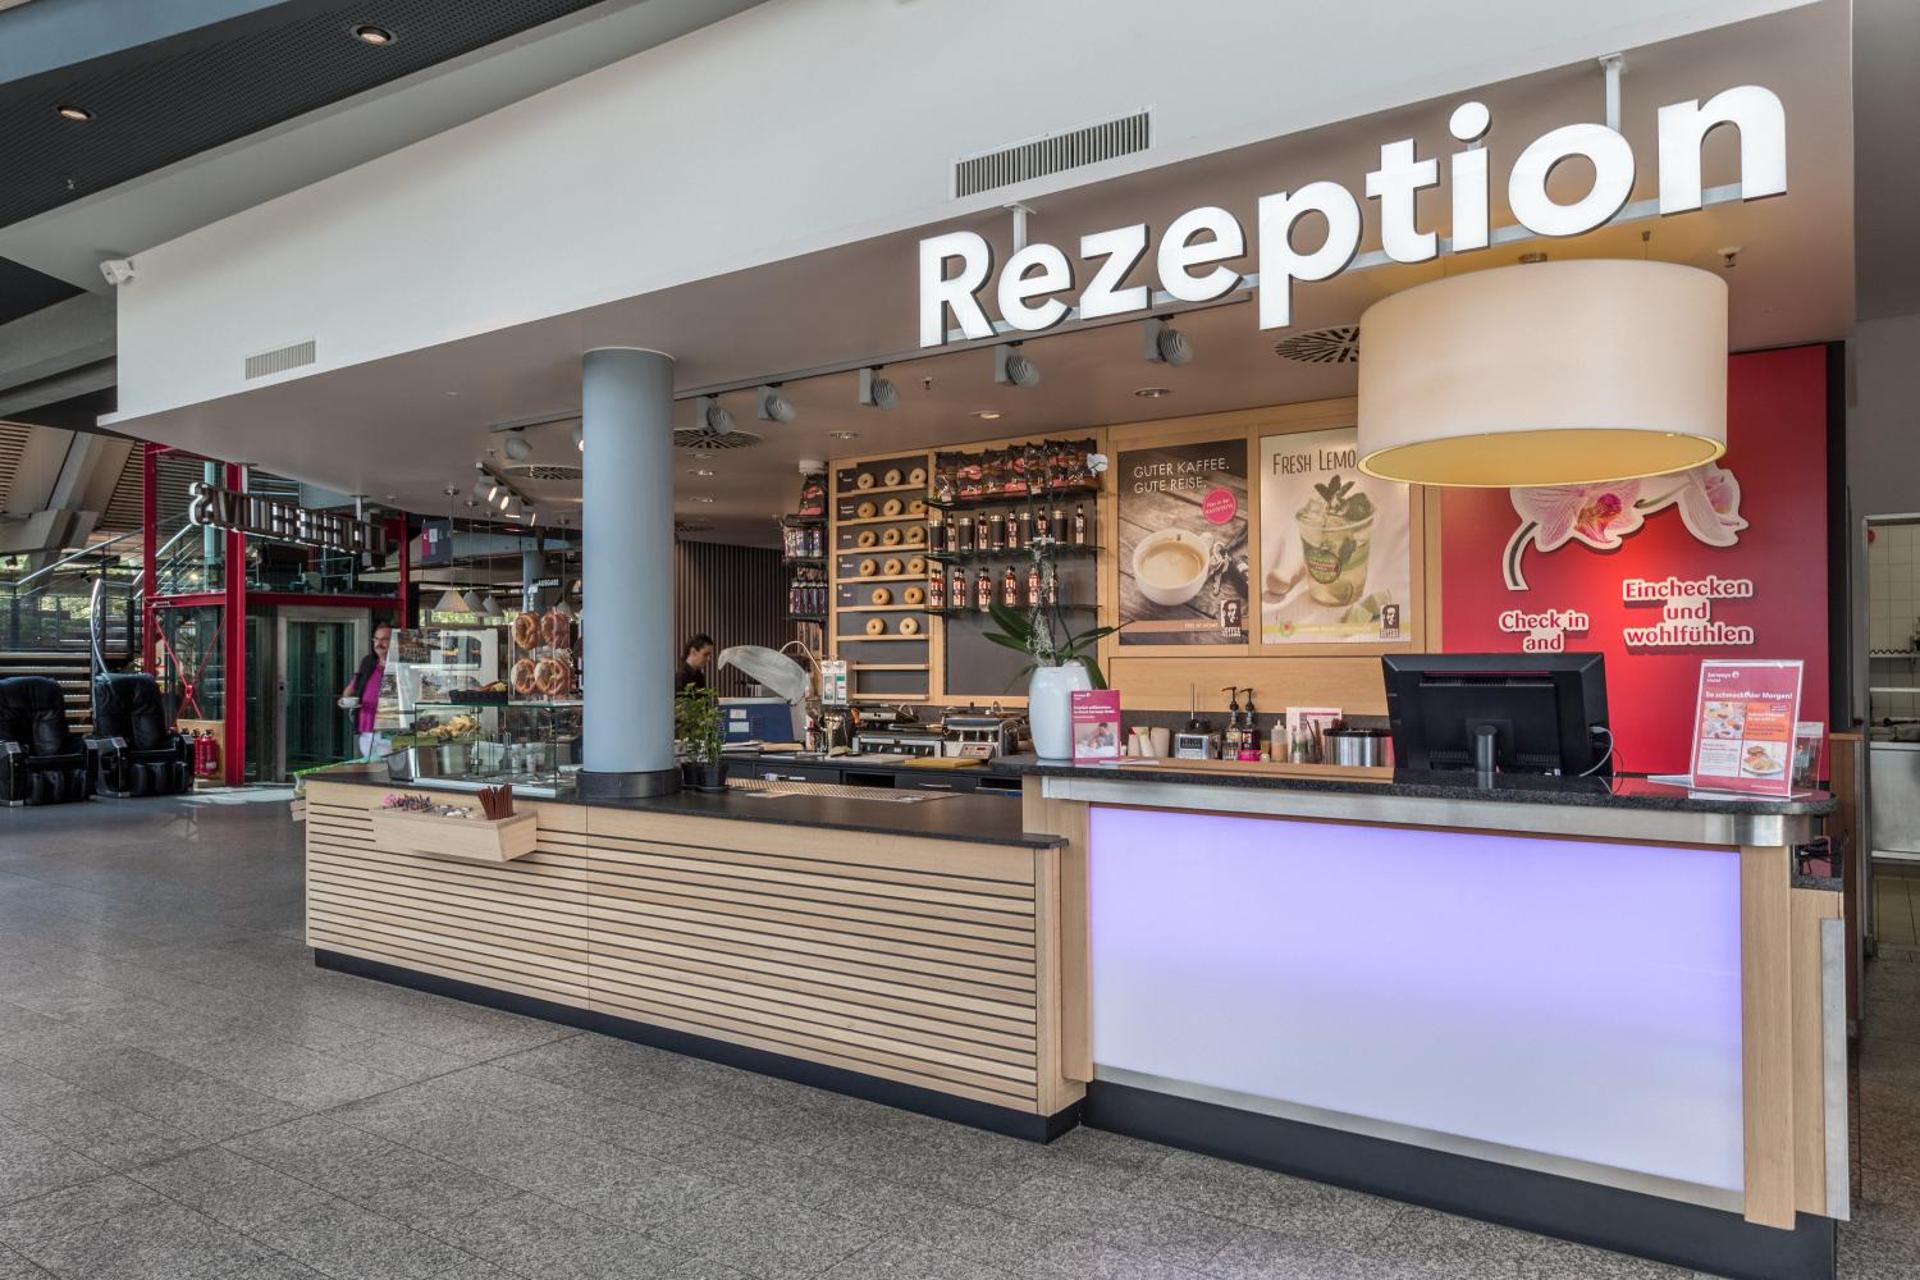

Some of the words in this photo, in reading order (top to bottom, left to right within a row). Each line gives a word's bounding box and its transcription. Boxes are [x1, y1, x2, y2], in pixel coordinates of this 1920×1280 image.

[917, 83, 1788, 348] Rezeption
[1133, 463, 1173, 478] GUTER
[1177, 457, 1230, 473] KAFFEE.
[1273, 453, 1312, 475] FRESH
[1133, 479, 1166, 494] GUTE
[1170, 477, 1207, 491] REISE.
[1624, 578, 1751, 599] Einchecken
[1666, 600, 1709, 620] und
[1500, 611, 1561, 630] Check
[1567, 611, 1587, 629] in
[1525, 633, 1563, 650] and
[1626, 624, 1752, 646] wohlfühlen
[1762, 691, 1792, 700] Morgen!
